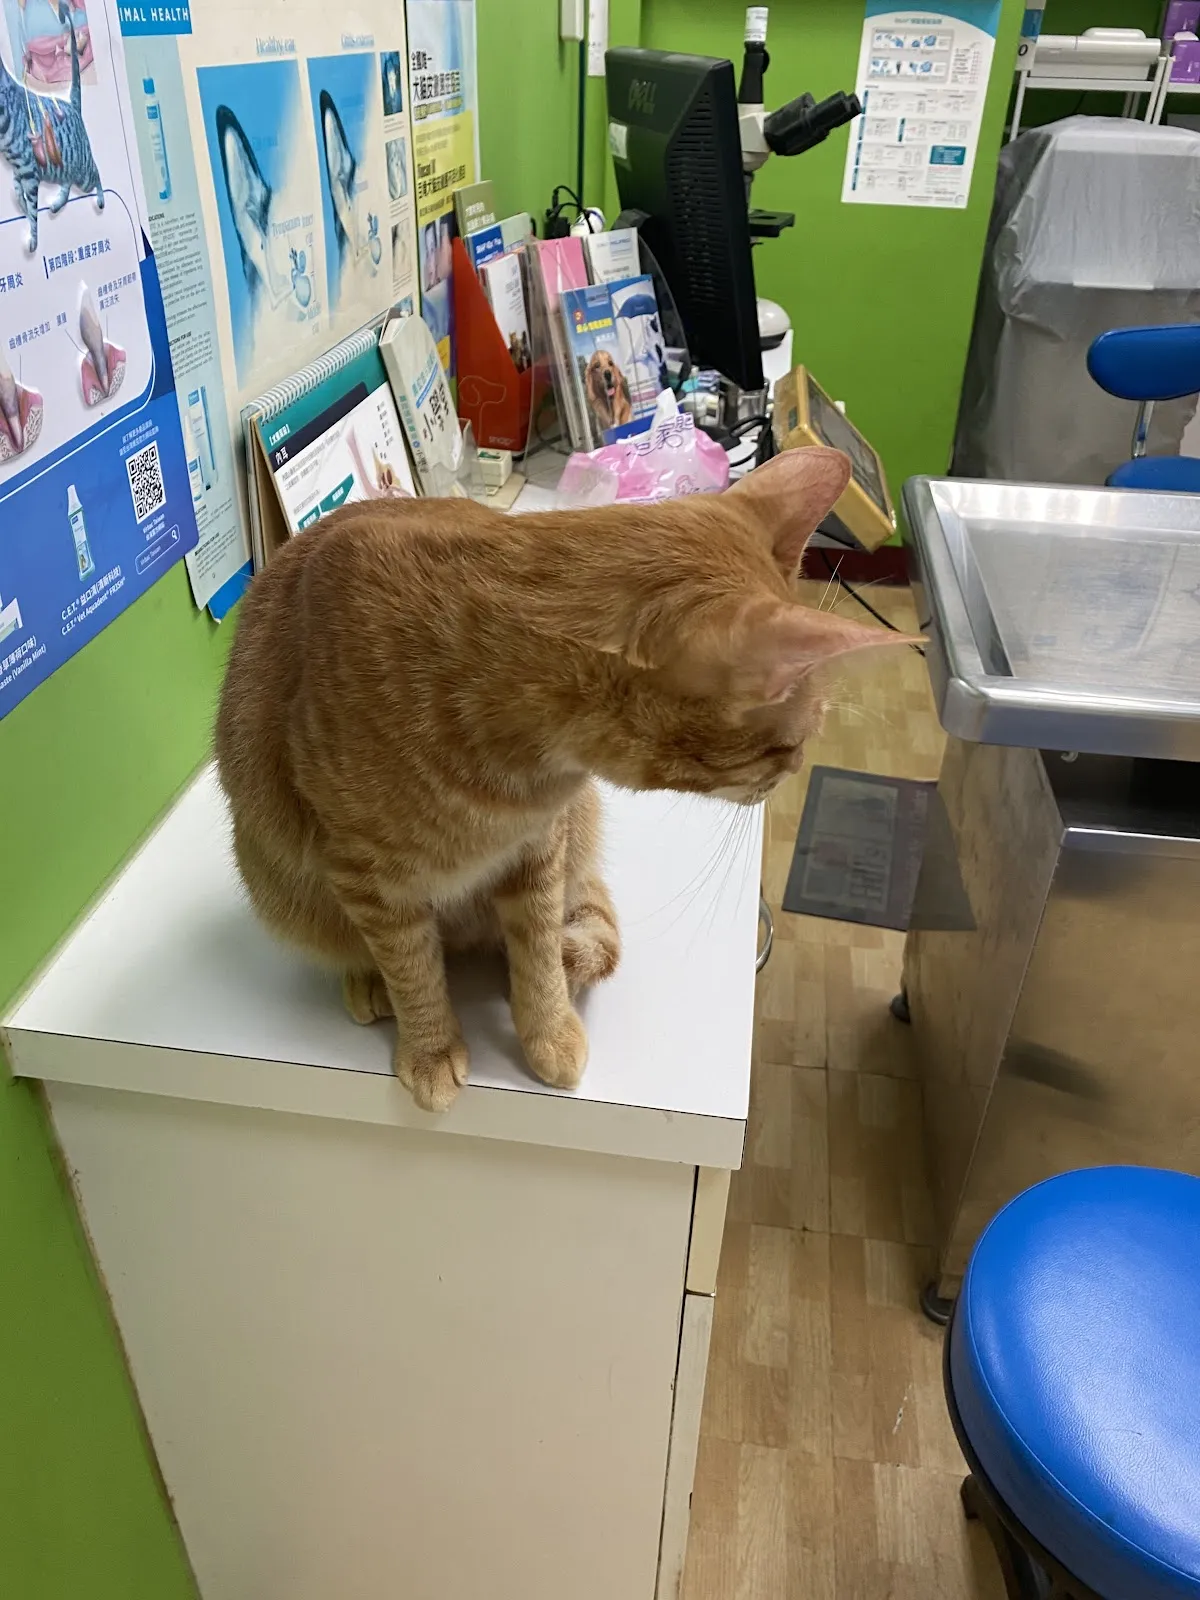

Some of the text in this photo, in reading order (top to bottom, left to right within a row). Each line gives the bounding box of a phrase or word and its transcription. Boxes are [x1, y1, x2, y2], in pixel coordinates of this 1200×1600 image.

[150, 7, 189, 22] HEALTH
[275, 446, 289, 465] 內耳
[77, 611, 86, 622] Vet
[32, 643, 47, 662] Mint)
